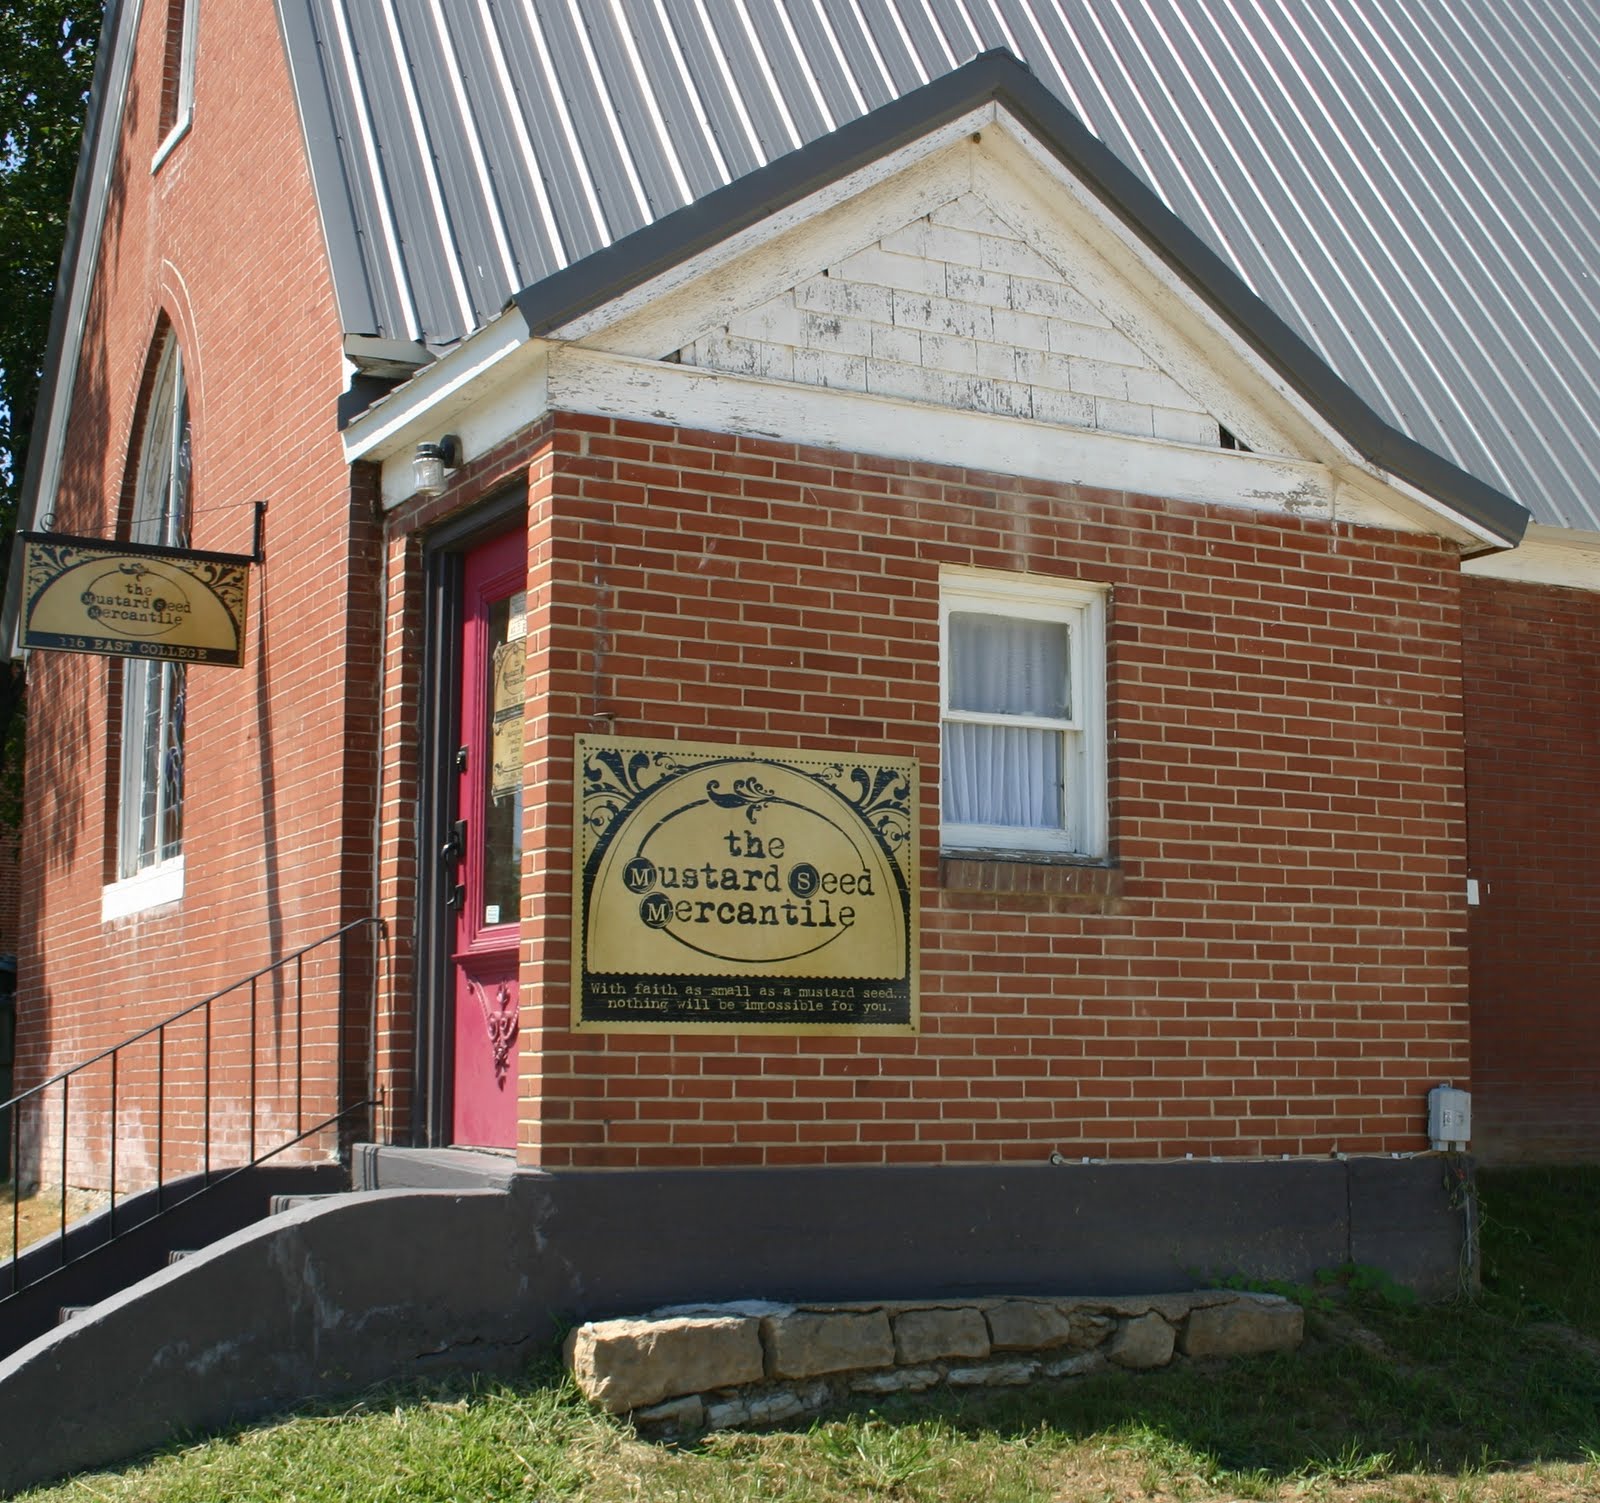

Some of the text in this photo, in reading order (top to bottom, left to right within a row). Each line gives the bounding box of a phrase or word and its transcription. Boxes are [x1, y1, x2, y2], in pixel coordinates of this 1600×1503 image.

[125, 583, 152, 596] the
[80, 591, 192, 614] Mustard Seed
[87, 605, 182, 625] Mercantile
[59, 636, 208, 660] 116 EAST COLLEGE
[724, 830, 785, 859] the
[622, 856, 875, 899] Mustard Seed
[639, 891, 856, 930] Mercantile
[591, 983, 626, 995] With
[634, 983, 678, 996] faith
[685, 985, 702, 996] as
[711, 985, 751, 997] small
[759, 986, 775, 997] as
[783, 987, 791, 997] a
[798, 987, 855, 998] mustard
[607, 998, 892, 1013] nothing will be impossible for you.
